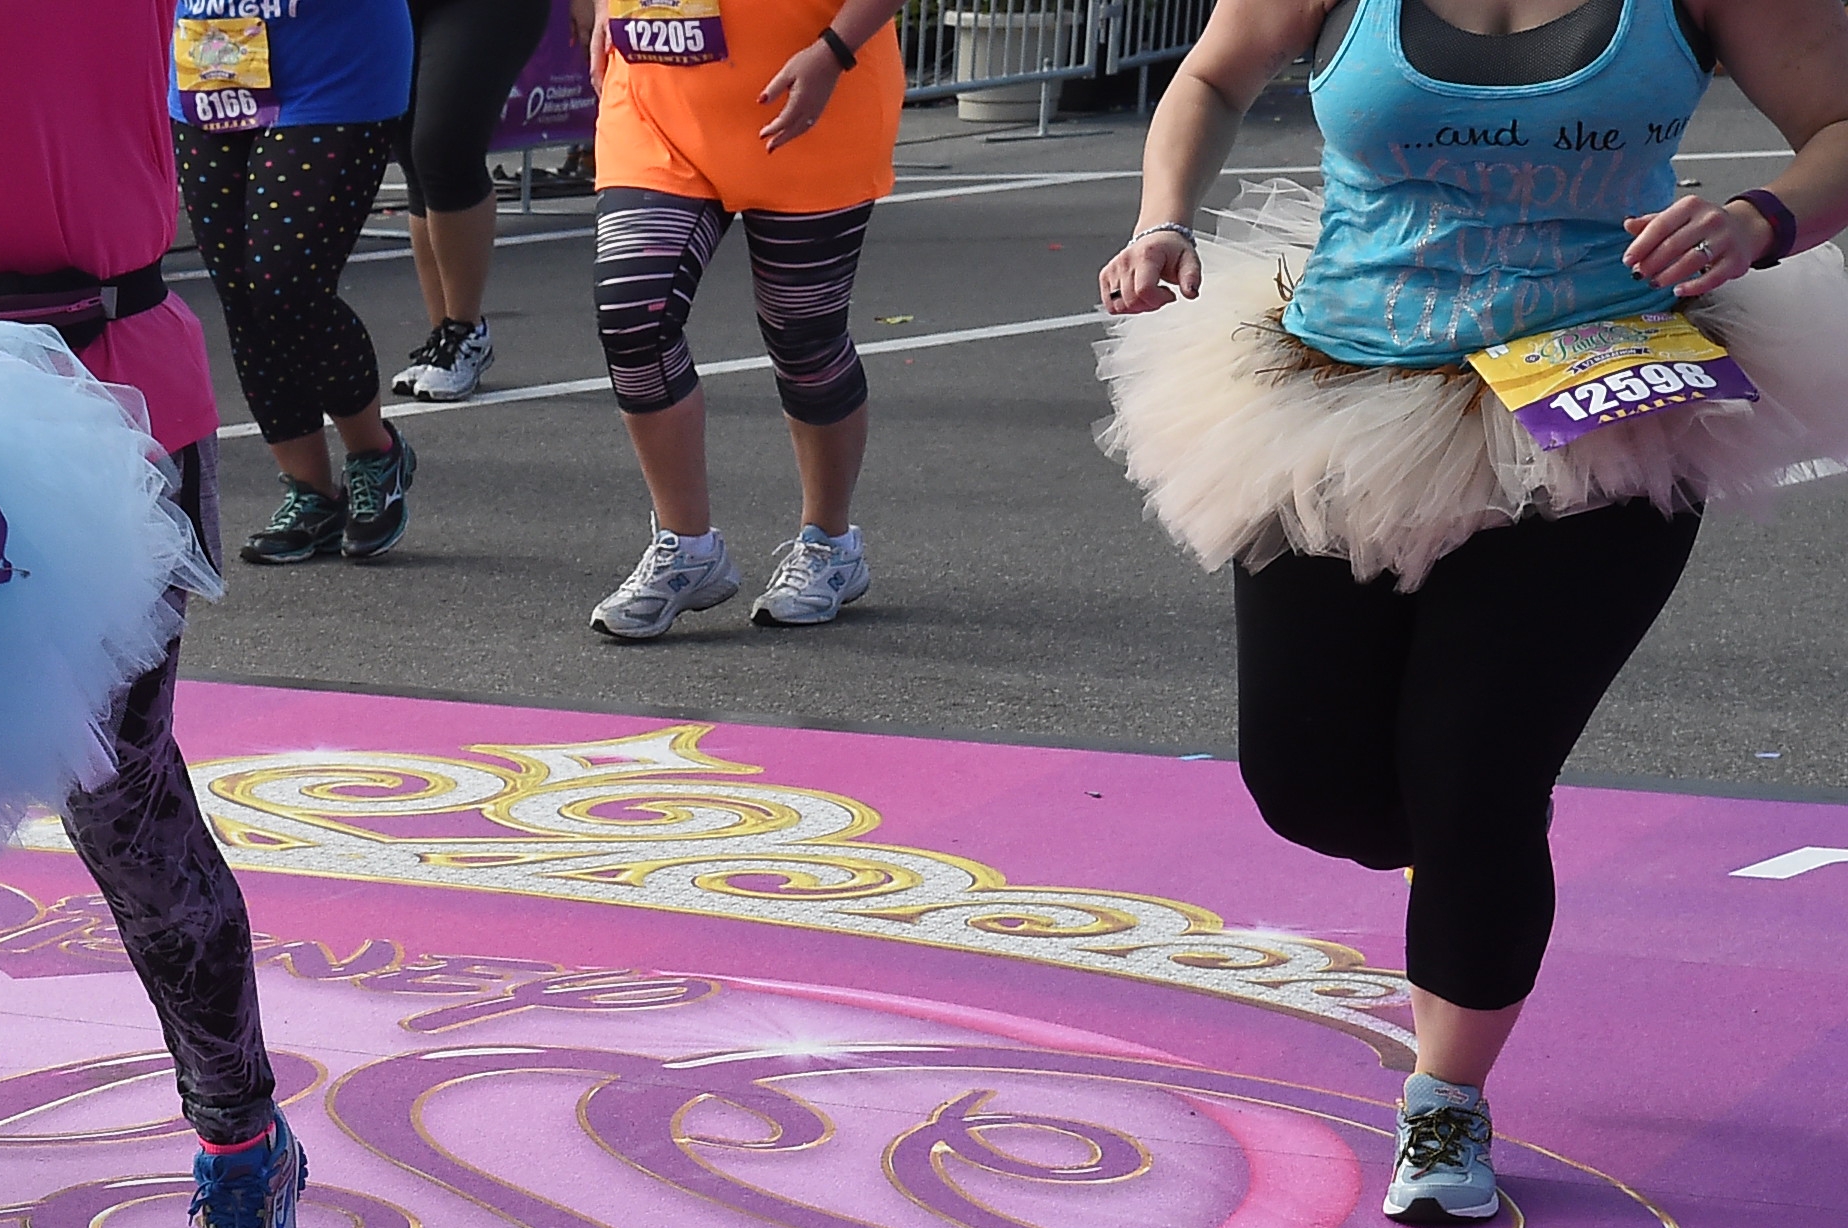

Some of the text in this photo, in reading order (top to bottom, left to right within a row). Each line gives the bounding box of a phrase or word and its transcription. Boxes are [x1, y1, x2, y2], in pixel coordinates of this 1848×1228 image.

[624, 20, 705, 53] 12205
[195, 89, 258, 121] 8166
[1553, 120, 1626, 151] she
[1549, 362, 1717, 421] 12598
[1597, 390, 1708, 425] ALAINA
